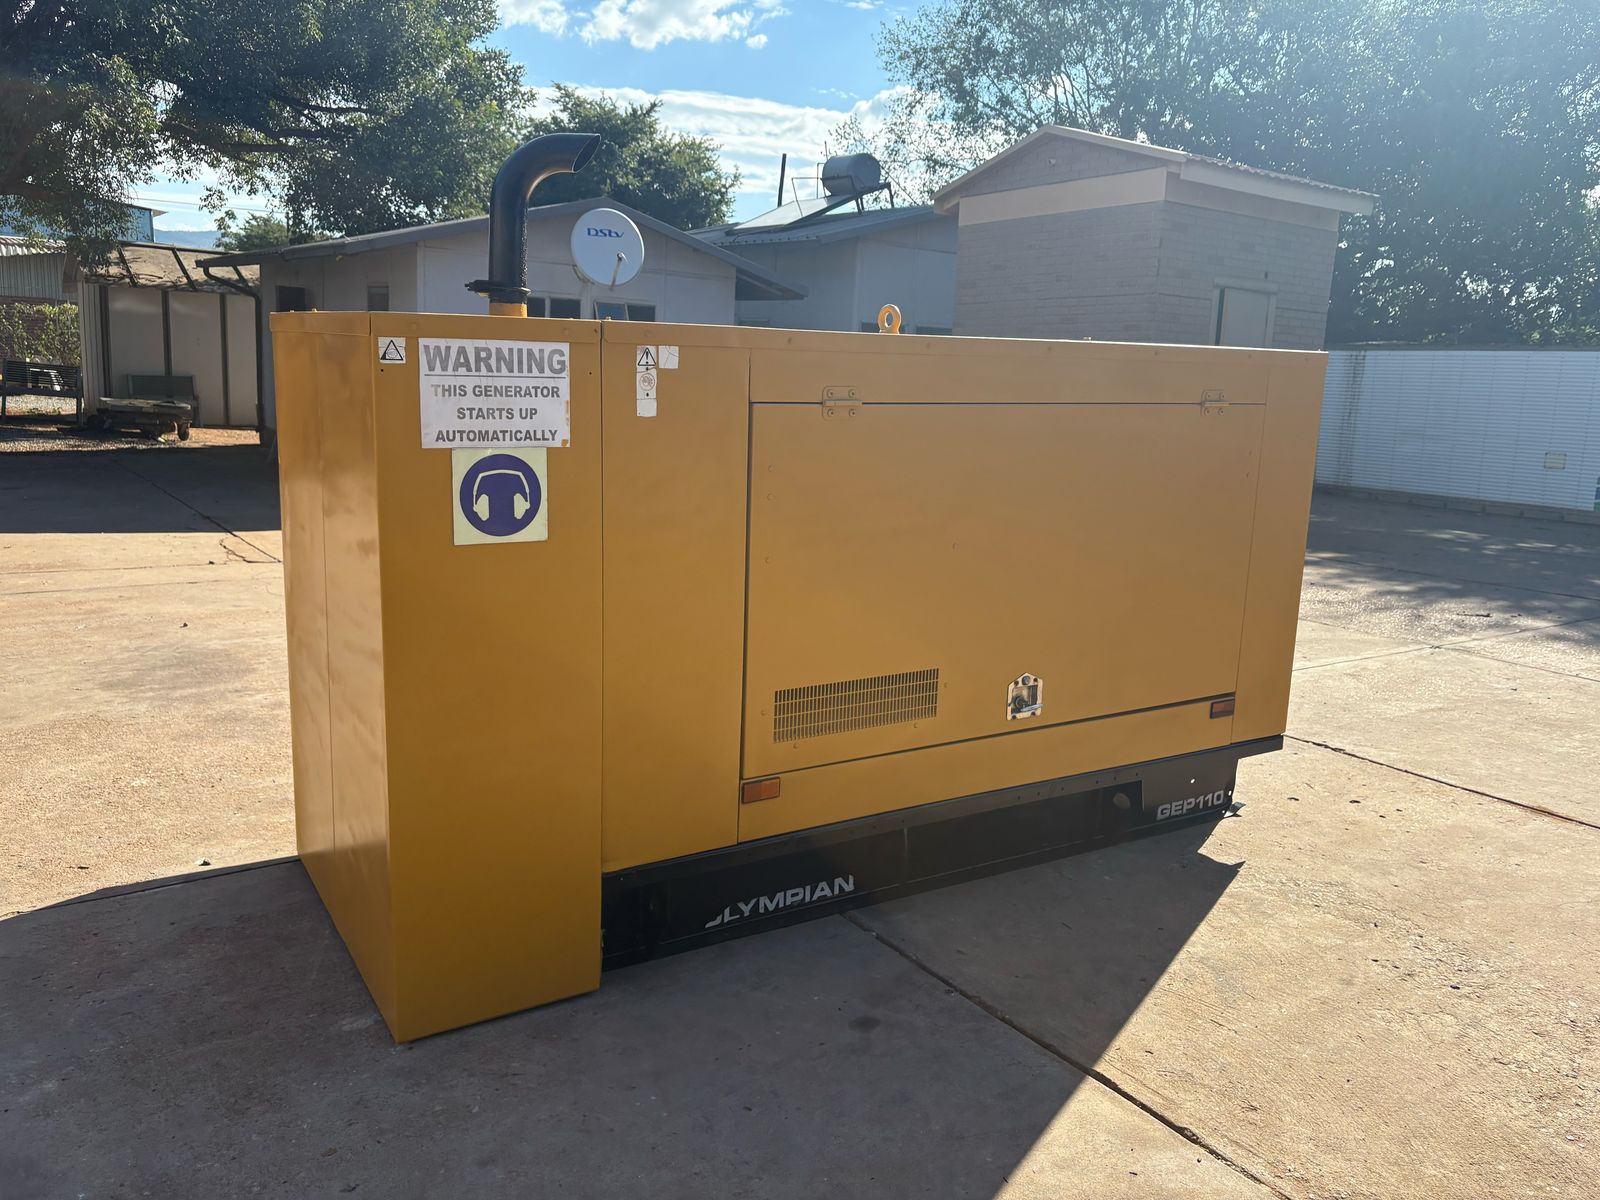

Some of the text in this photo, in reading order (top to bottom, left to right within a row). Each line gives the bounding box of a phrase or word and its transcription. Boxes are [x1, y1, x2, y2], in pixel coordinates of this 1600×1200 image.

[587, 227, 624, 238] DStv
[423, 344, 566, 375] WARNING
[431, 384, 561, 398] THIS GENERATOR
[456, 407, 538, 420] STARTS UP
[435, 429, 558, 442] AUTOMATICALLY
[1156, 790, 1225, 821] GEP110
